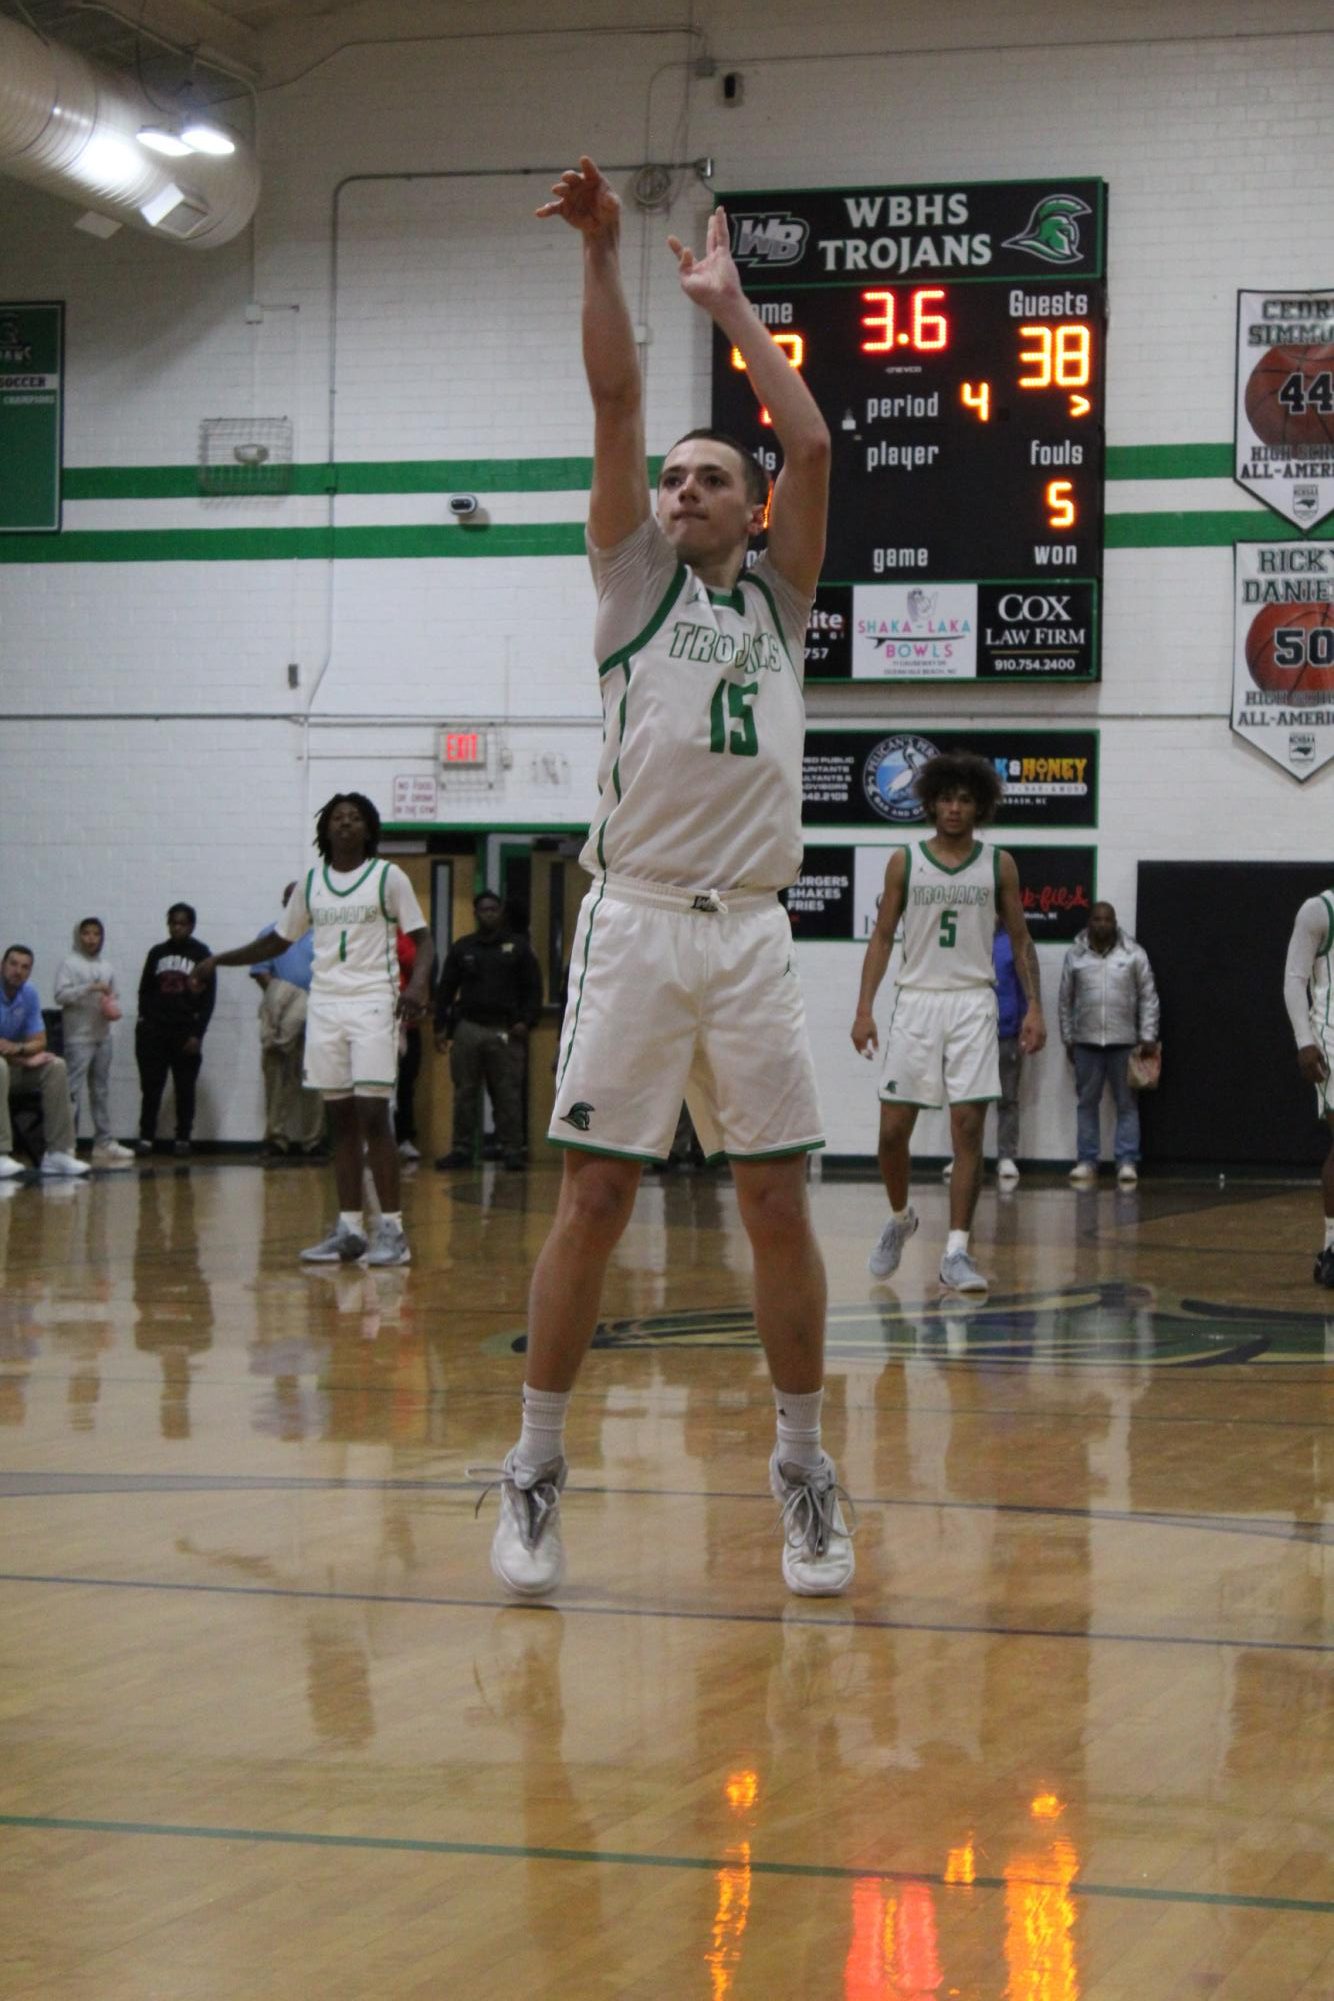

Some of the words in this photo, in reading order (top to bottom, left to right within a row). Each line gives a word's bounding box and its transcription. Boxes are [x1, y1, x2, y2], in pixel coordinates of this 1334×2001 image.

[845, 193, 969, 229] WBHS
[738, 219, 803, 260] WB
[818, 233, 992, 274] TROJANS
[1009, 290, 1088, 317] Guests
[1262, 300, 1334, 320] CEDR
[861, 290, 948, 352] 3.6
[1018, 325, 1091, 387] 38
[961, 382, 990, 422] 4
[1279, 372, 1334, 414] 44
[866, 392, 939, 424] period
[866, 441, 939, 472] player
[1030, 439, 1083, 465] fouls
[1046, 481, 1075, 527] 5
[873, 547, 929, 573] game
[1034, 545, 1078, 565] won
[998, 594, 1072, 622] COX
[669, 621, 781, 672] TROJANS
[885, 643, 954, 658] BOWLS
[985, 627, 1030, 646] LAW
[1034, 627, 1086, 645] FIRM
[1274, 626, 1334, 667] 50
[994, 658, 1076, 671] 910.754.2400
[710, 678, 759, 757] 15
[1238, 711, 1334, 727] ALL-AMERI
[447, 733, 478, 761] EXIT
[788, 888, 841, 899] SHAKES
[795, 876, 848, 888] URGERS
[913, 885, 989, 906] TROJANS
[787, 900, 825, 911] FRIES
[938, 910, 958, 948] 5
[339, 930, 347, 962] 1
